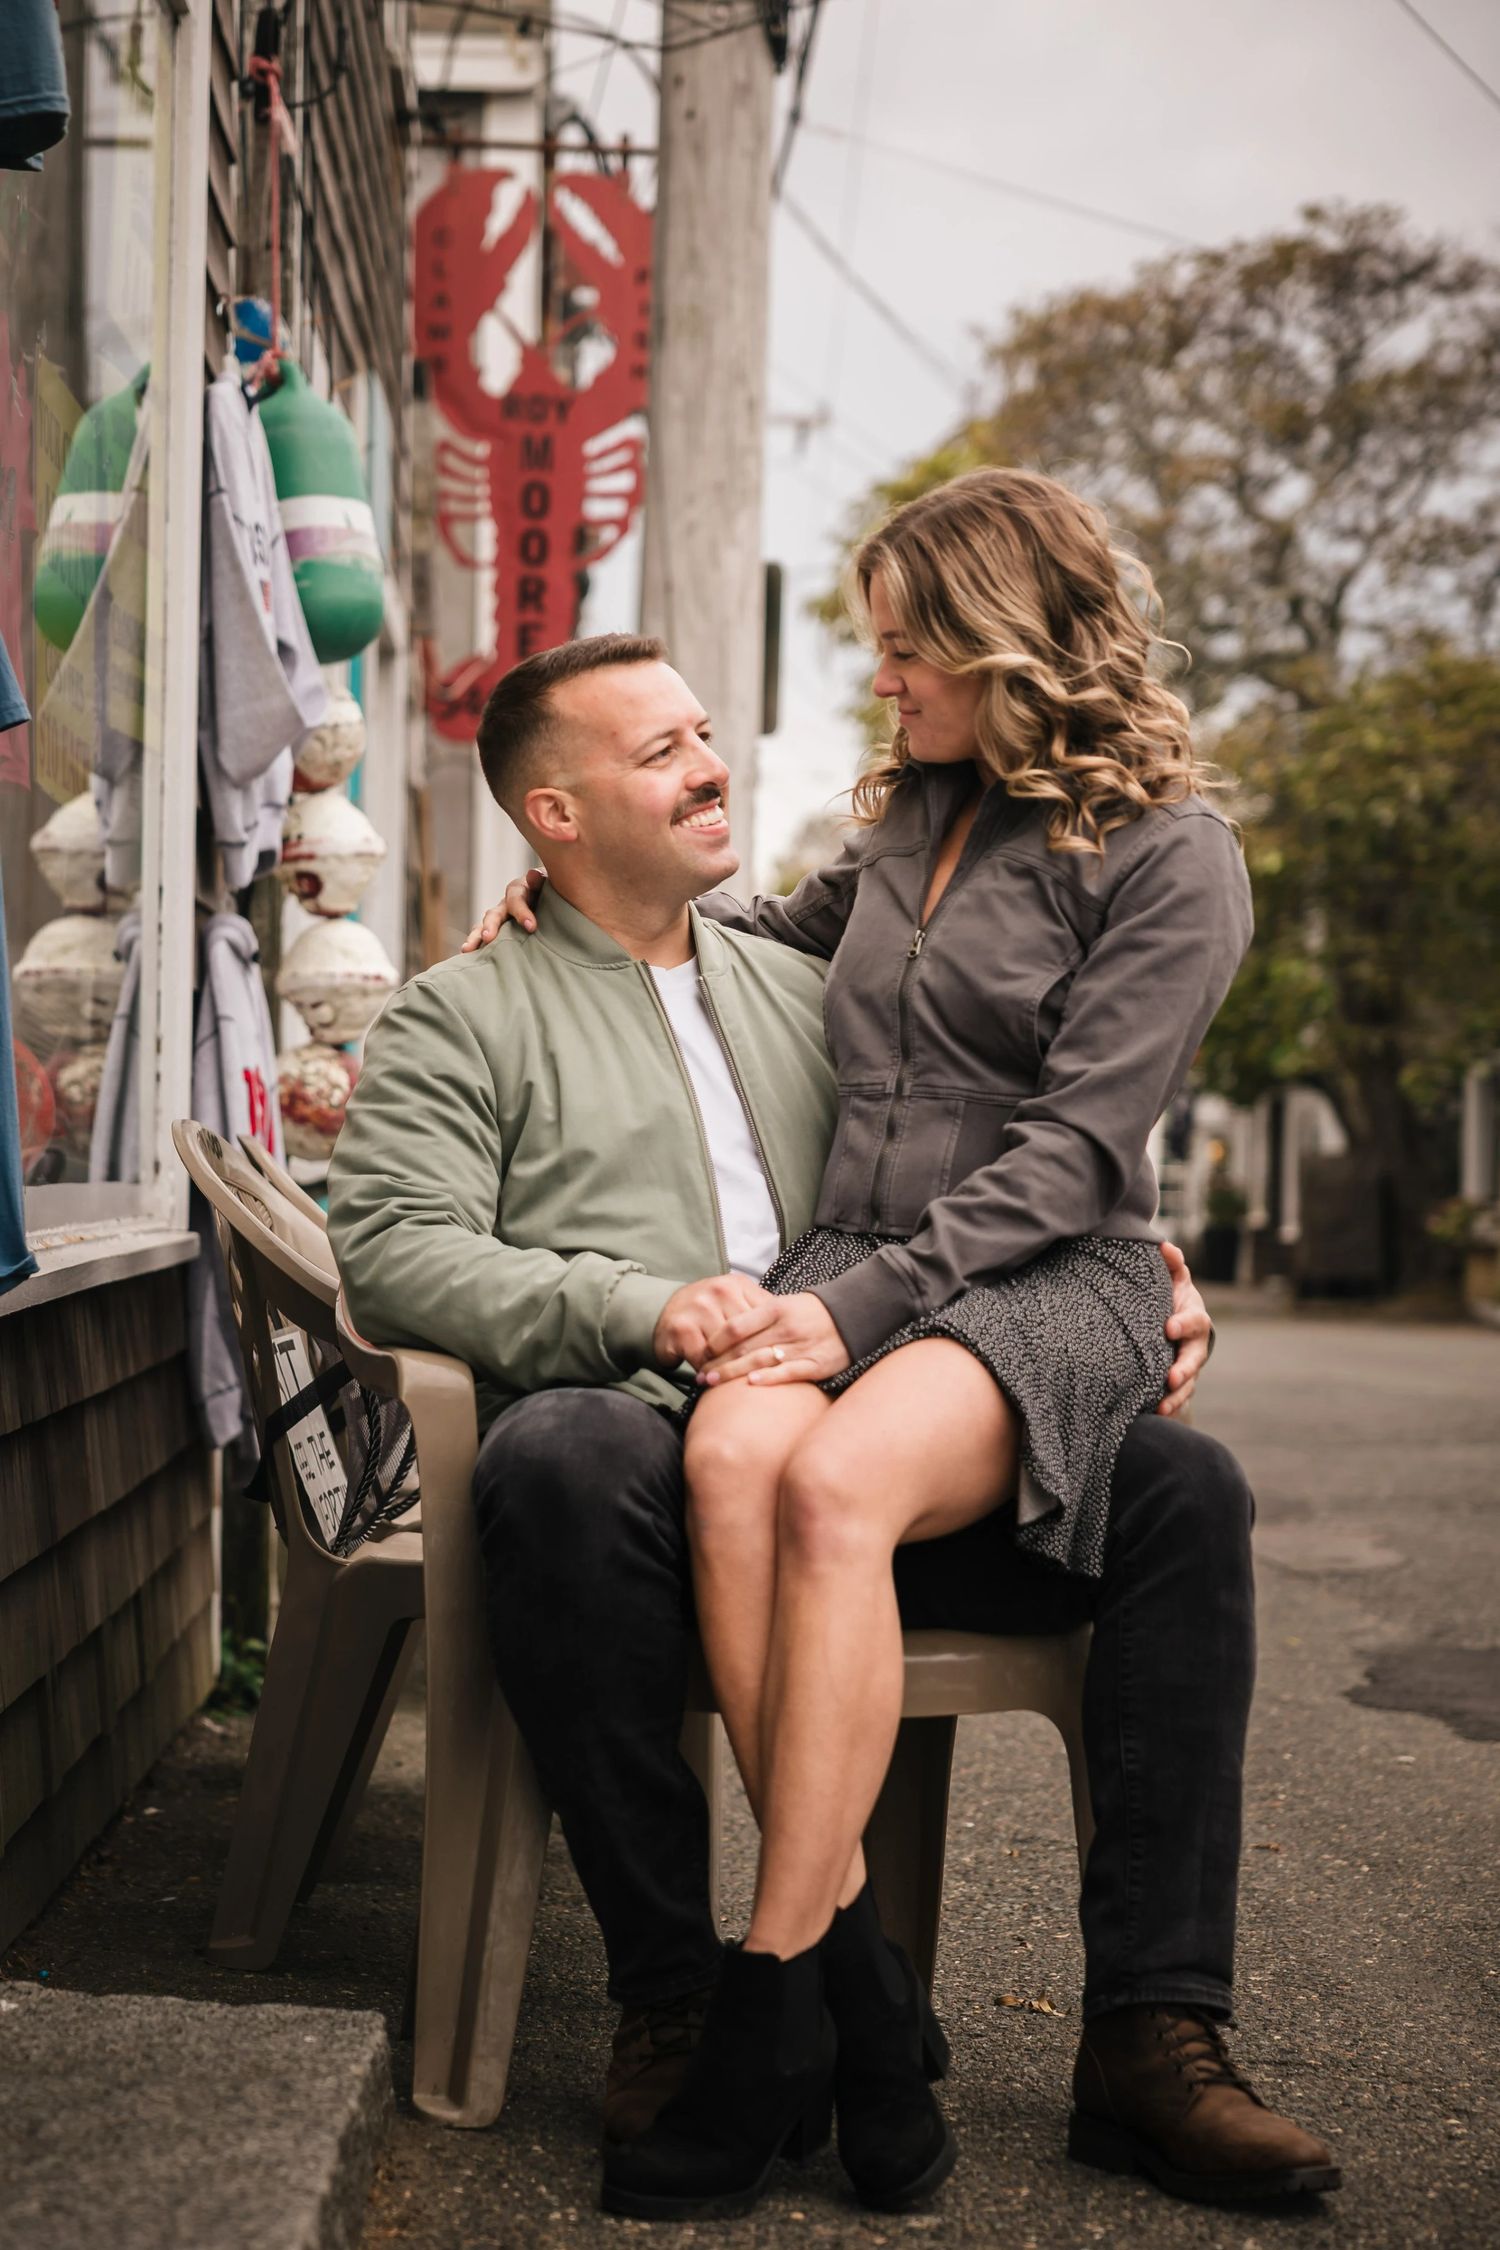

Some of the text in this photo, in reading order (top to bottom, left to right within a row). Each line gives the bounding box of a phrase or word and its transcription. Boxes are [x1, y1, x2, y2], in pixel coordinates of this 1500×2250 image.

[502, 394, 572, 424] ROY
[516, 433, 554, 660] MOORE
[307, 1431, 336, 1476] THE
